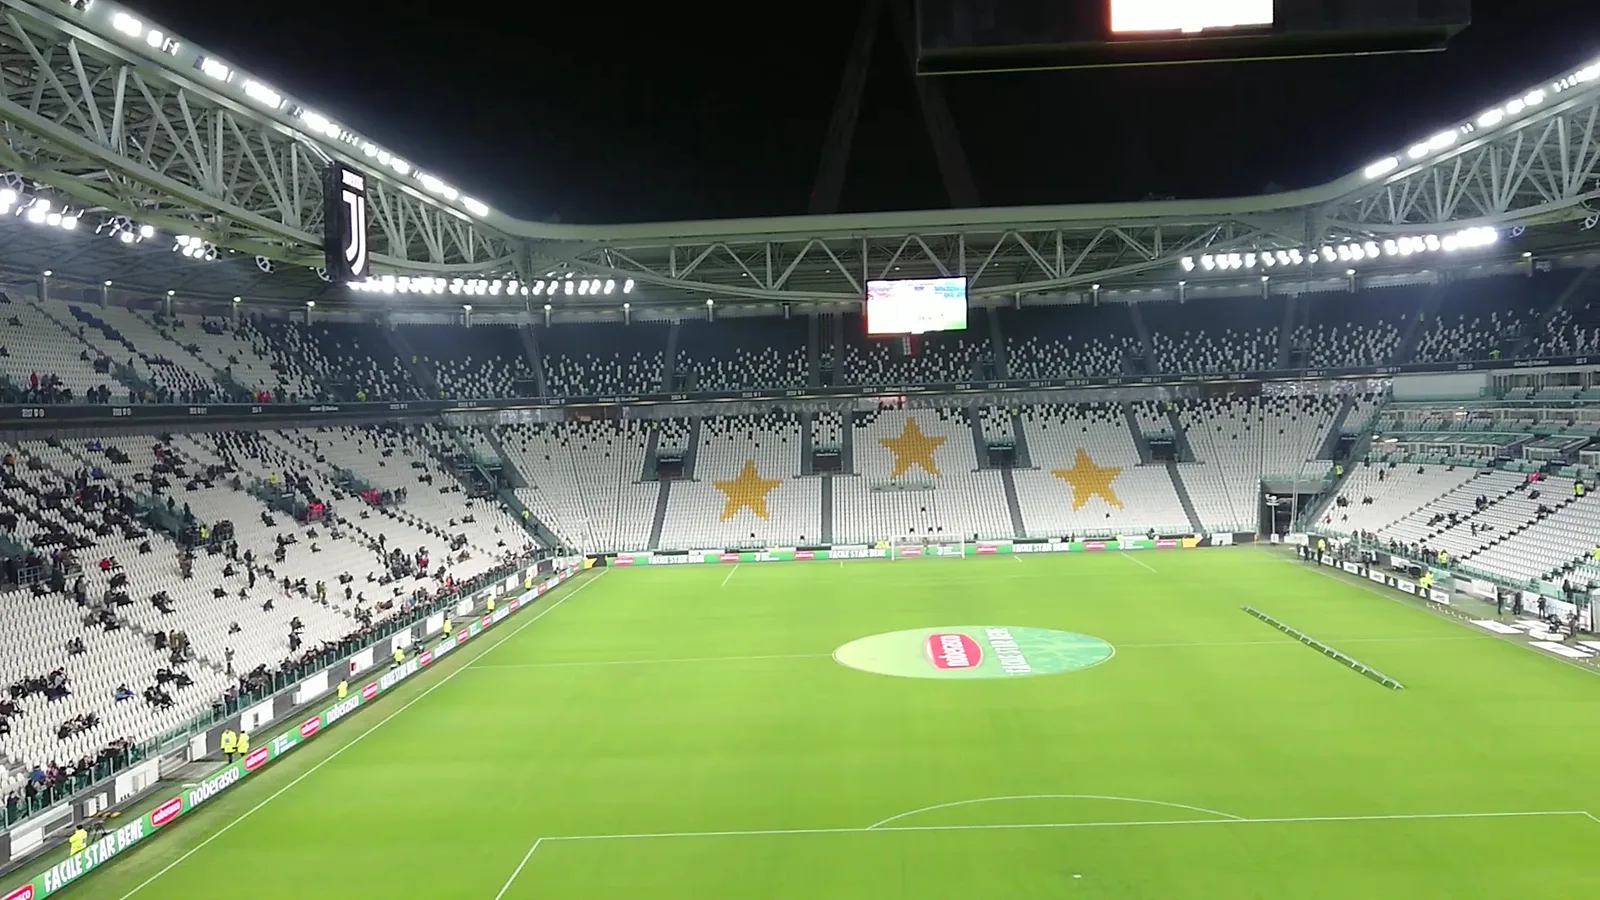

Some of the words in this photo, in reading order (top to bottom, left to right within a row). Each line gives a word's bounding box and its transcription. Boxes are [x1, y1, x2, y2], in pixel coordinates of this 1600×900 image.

[189, 766, 240, 807] noberasco
[44, 854, 83, 893] FACILE
[84, 834, 116, 869] STAR
[117, 817, 143, 851] BENE
